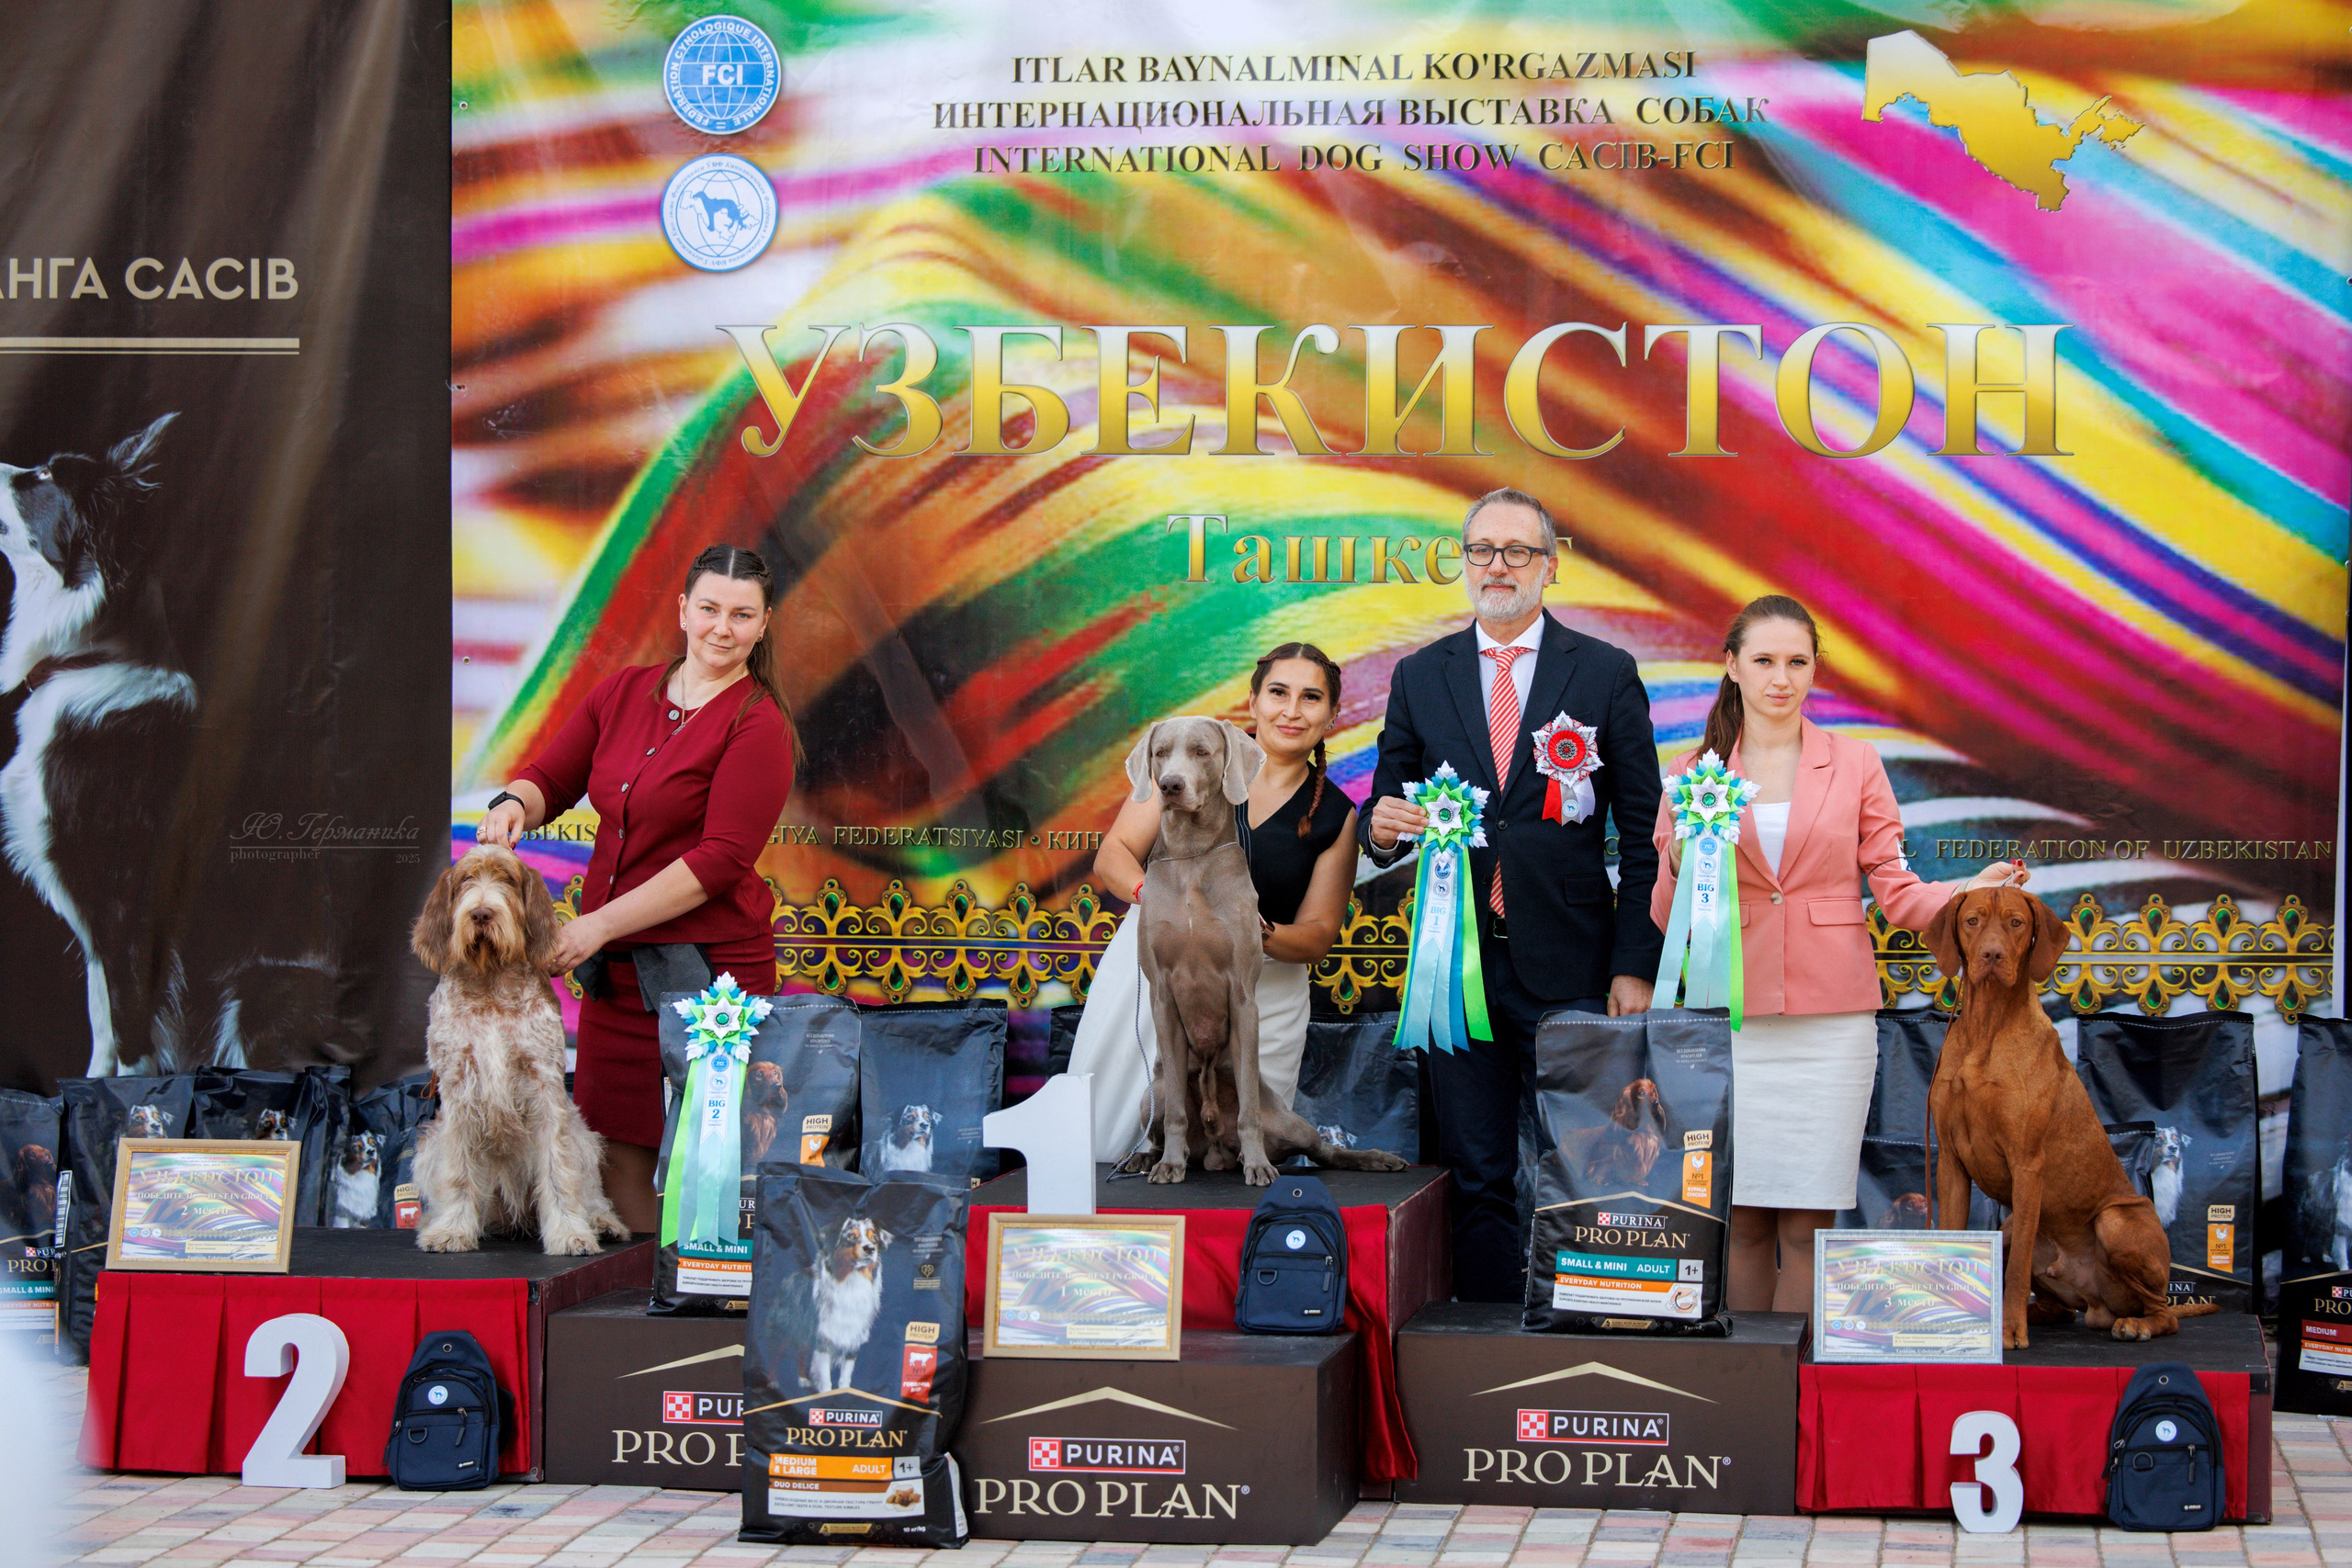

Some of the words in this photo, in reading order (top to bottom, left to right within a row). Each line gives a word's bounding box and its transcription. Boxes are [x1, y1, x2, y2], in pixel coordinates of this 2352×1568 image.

[675, 22, 752, 59] CYNOLOGIQUE
[703, 64, 743, 85] FCI
[1012, 56, 1127, 84] ITLAR
[1137, 54, 1414, 83] BAYNALMINAL
[1422, 51, 1698, 81] KO'RGAZMASI
[733, 35, 775, 126] INTERNATIONALE
[670, 62, 709, 126] FEDERATION
[932, 99, 1386, 134] ИНТЕРНАЦИОНАЛЬНАЯ
[1397, 96, 1615, 127] ВЫСТАВКА
[1636, 96, 1770, 124] СОБАК
[972, 144, 1281, 174] INTERNATIONAL
[1296, 143, 1382, 172] DOG
[1403, 142, 1519, 172] SHOW
[1538, 141, 1736, 170] CACIB-FCI
[715, 322, 2075, 459] УЗБЕКИСТОН
[1166, 513, 1573, 585] Ташке
[520, 823, 598, 842] BEKIS
[766, 826, 821, 846] GIYA
[832, 826, 1025, 849] FEDERATSIYASI
[1046, 830, 1103, 851] КИН
[1934, 838, 2107, 860] FEDERATION
[2112, 838, 2151, 860] OF
[2163, 839, 2333, 861] UZBEKISTAN
[1702, 893, 1709, 903] 3
[1430, 906, 1446, 915] BIG
[1433, 917, 1438, 926] 1
[708, 1100, 726, 1108] BIG
[712, 1109, 720, 1119] 2
[983, 1073, 1095, 1214] 1
[181, 1206, 188, 1216] 2
[193, 1207, 229, 1216] место
[1611, 1217, 1663, 1227] PURINA
[1575, 1226, 1622, 1245] PRO
[1625, 1230, 1688, 1249] PLAN
[684, 1243, 715, 1252] SMALL
[725, 1245, 748, 1254] MINI
[7, 1259, 47, 1272] PRO
[1561, 1258, 1593, 1269] SMALL
[1595, 1260, 1602, 1269] &
[1603, 1260, 1627, 1271] MINI
[1637, 1264, 1670, 1274] ADULT
[1685, 1266, 1698, 1275] 1+
[1560, 1277, 1598, 1287] EVERYDAY
[1600, 1280, 1642, 1290] NUTRITION
[1061, 1286, 1066, 1297] 1
[1074, 1287, 1112, 1297] место
[1884, 1297, 1892, 1307] 3
[1897, 1299, 1935, 1307] место
[2314, 1299, 2352, 1314] PRO
[910, 1325, 935, 1334] HIGH
[2306, 1325, 2337, 1337] MEDIUM
[242, 1313, 349, 1489] 2
[827, 1412, 878, 1424] PURINA
[1554, 1416, 1661, 1438] PURINA
[786, 1427, 835, 1446] PRO
[840, 1429, 904, 1448] PLAN
[612, 1430, 716, 1466] PRO
[1067, 1444, 1177, 1466] PURINA
[774, 1457, 817, 1466] MEDIUM
[853, 1464, 886, 1473] ADULT
[899, 1462, 913, 1473] 1+
[783, 1466, 818, 1475] LARGE
[1463, 1449, 1571, 1484] PRO
[1581, 1451, 1722, 1489] PLAN
[1950, 1410, 2024, 1533] 3
[792, 1482, 820, 1490] DELICE
[974, 1479, 1086, 1516] PRO
[1095, 1481, 1241, 1519] PLAN
